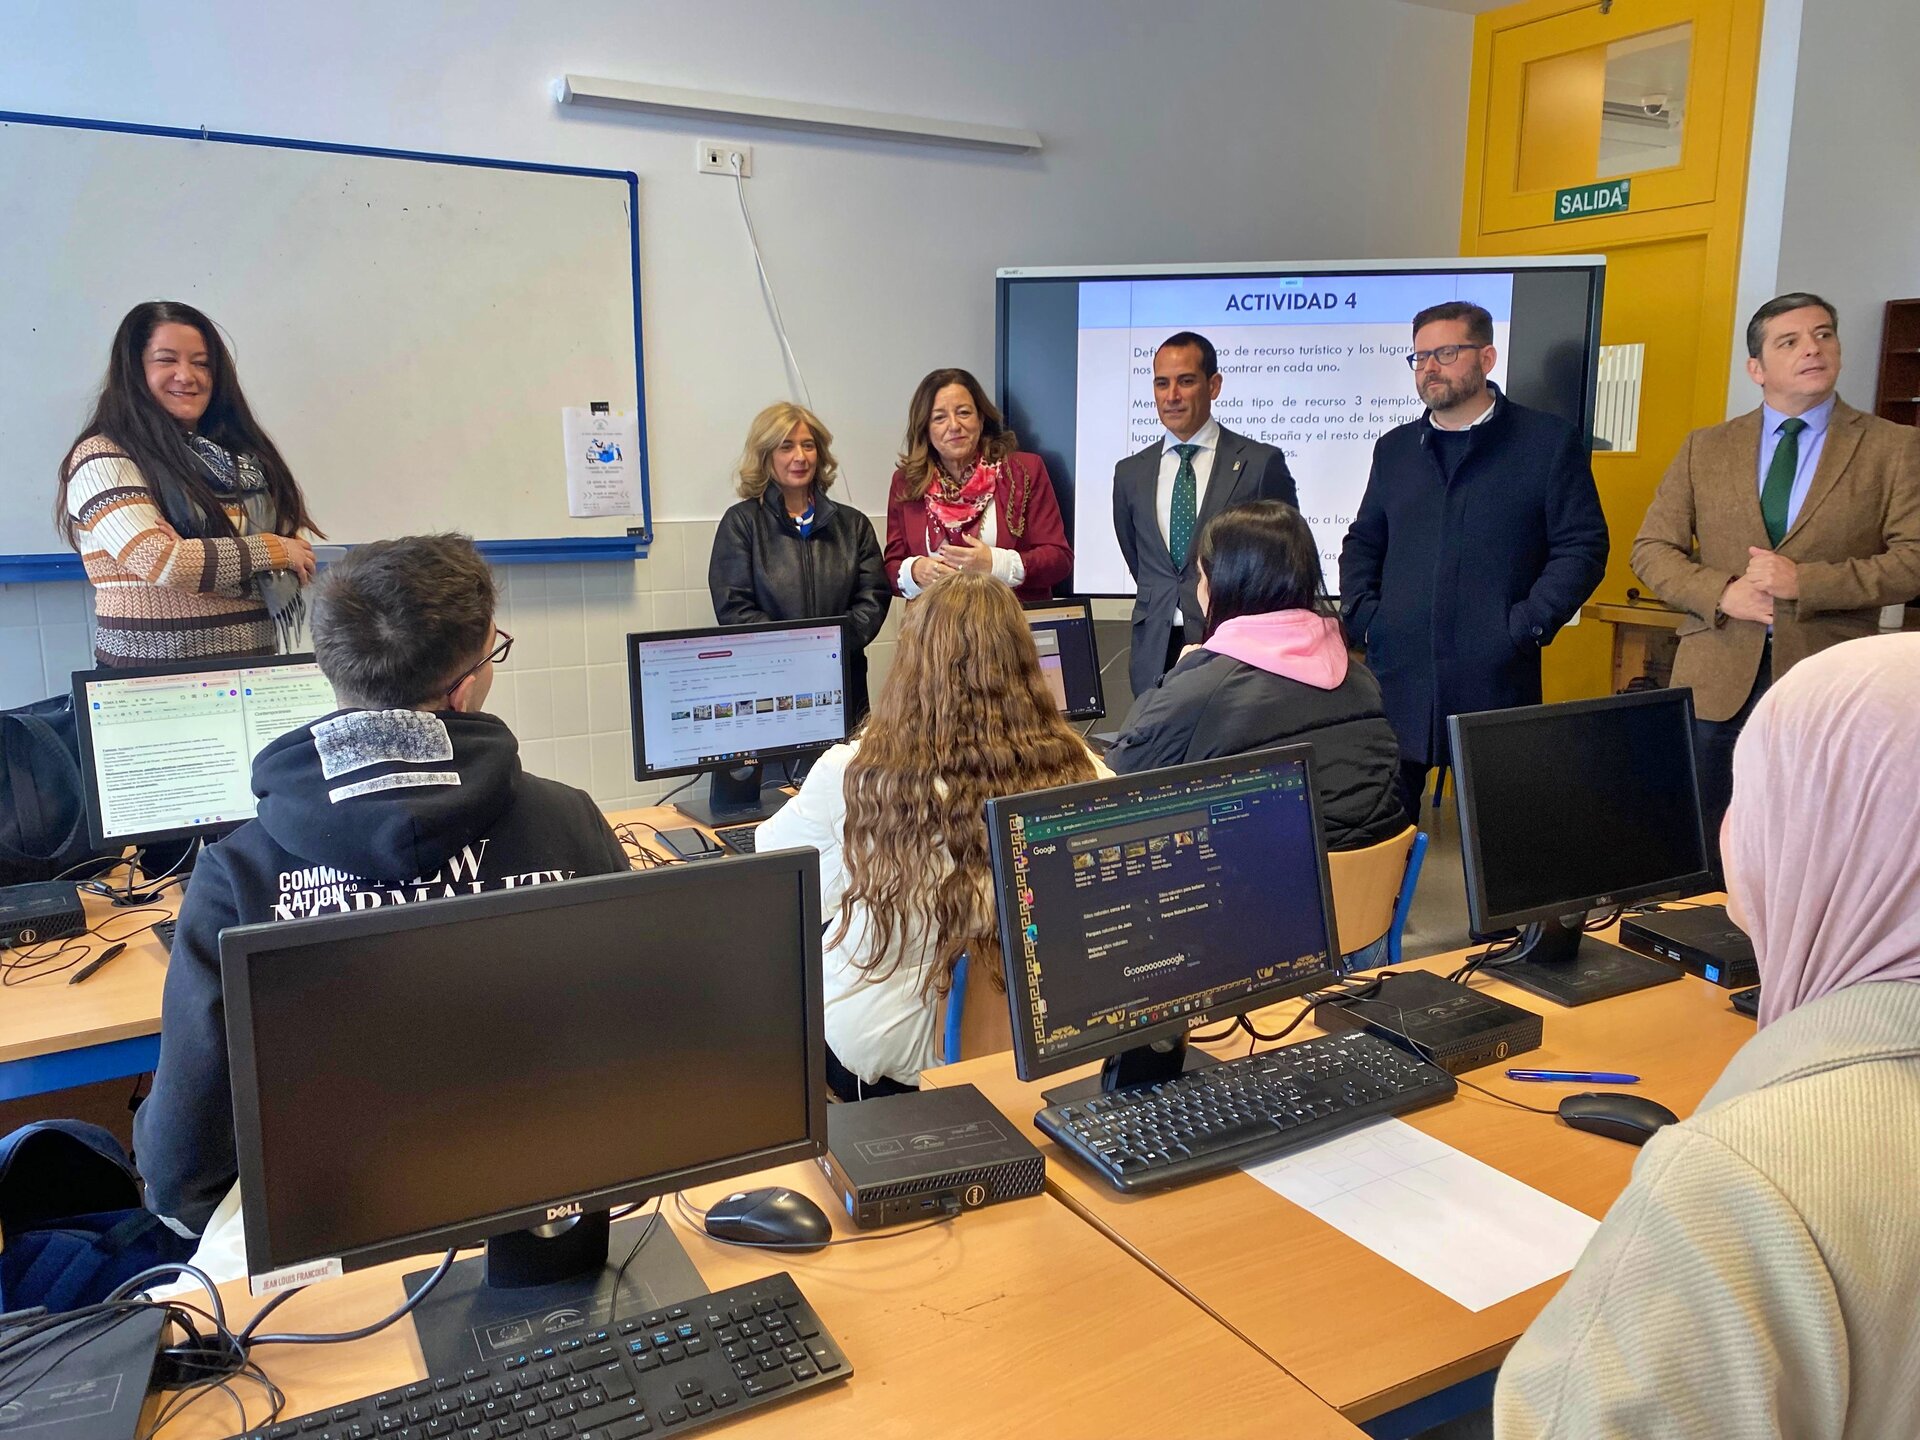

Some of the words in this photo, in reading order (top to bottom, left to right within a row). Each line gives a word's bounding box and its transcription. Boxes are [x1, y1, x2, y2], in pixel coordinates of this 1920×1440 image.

[1561, 187, 1622, 214] SALIDA
[1225, 293, 1338, 311] ACTIVIDAD
[1344, 292, 1357, 309] 4
[1134, 347, 1157, 358] Defi
[1235, 345, 1249, 356] de
[1254, 347, 1295, 356] recurso
[1299, 344, 1342, 356] turístico
[1347, 346, 1354, 357] y
[1359, 344, 1374, 354] los
[1379, 343, 1414, 356] lugare
[1133, 367, 1151, 375] nos
[1217, 364, 1263, 374] ncontrar
[1266, 365, 1280, 373] en
[1283, 362, 1313, 373] cada
[1317, 364, 1340, 372] uno.
[1214, 397, 1243, 407] cada
[1252, 398, 1274, 409] tipo
[1282, 396, 1297, 407] de
[1305, 398, 1346, 407] recurso
[1355, 395, 1362, 406] 3
[1370, 395, 1422, 408] ejemplos
[1246, 416, 1266, 424] uno
[1271, 414, 1286, 424] de
[1290, 413, 1320, 424] cada
[1324, 415, 1345, 423] uno
[1349, 413, 1364, 423] de
[1369, 412, 1384, 423] los
[1260, 430, 1301, 443] España
[1305, 432, 1312, 442] y
[1316, 430, 1327, 440] el
[1331, 431, 1359, 441] resto
[1363, 430, 1381, 440] del
[1323, 516, 1331, 525] a
[1335, 514, 1350, 525] los
[1033, 844, 1057, 855] Google
[279, 865, 366, 893] COMMU
[279, 883, 345, 911] CATION
[345, 883, 358, 893] 4.0
[1188, 1014, 1209, 1028] DELL
[546, 1202, 584, 1220] DELL
[263, 1280, 278, 1290] JEAN
[278, 1275, 296, 1287] LOUIS
